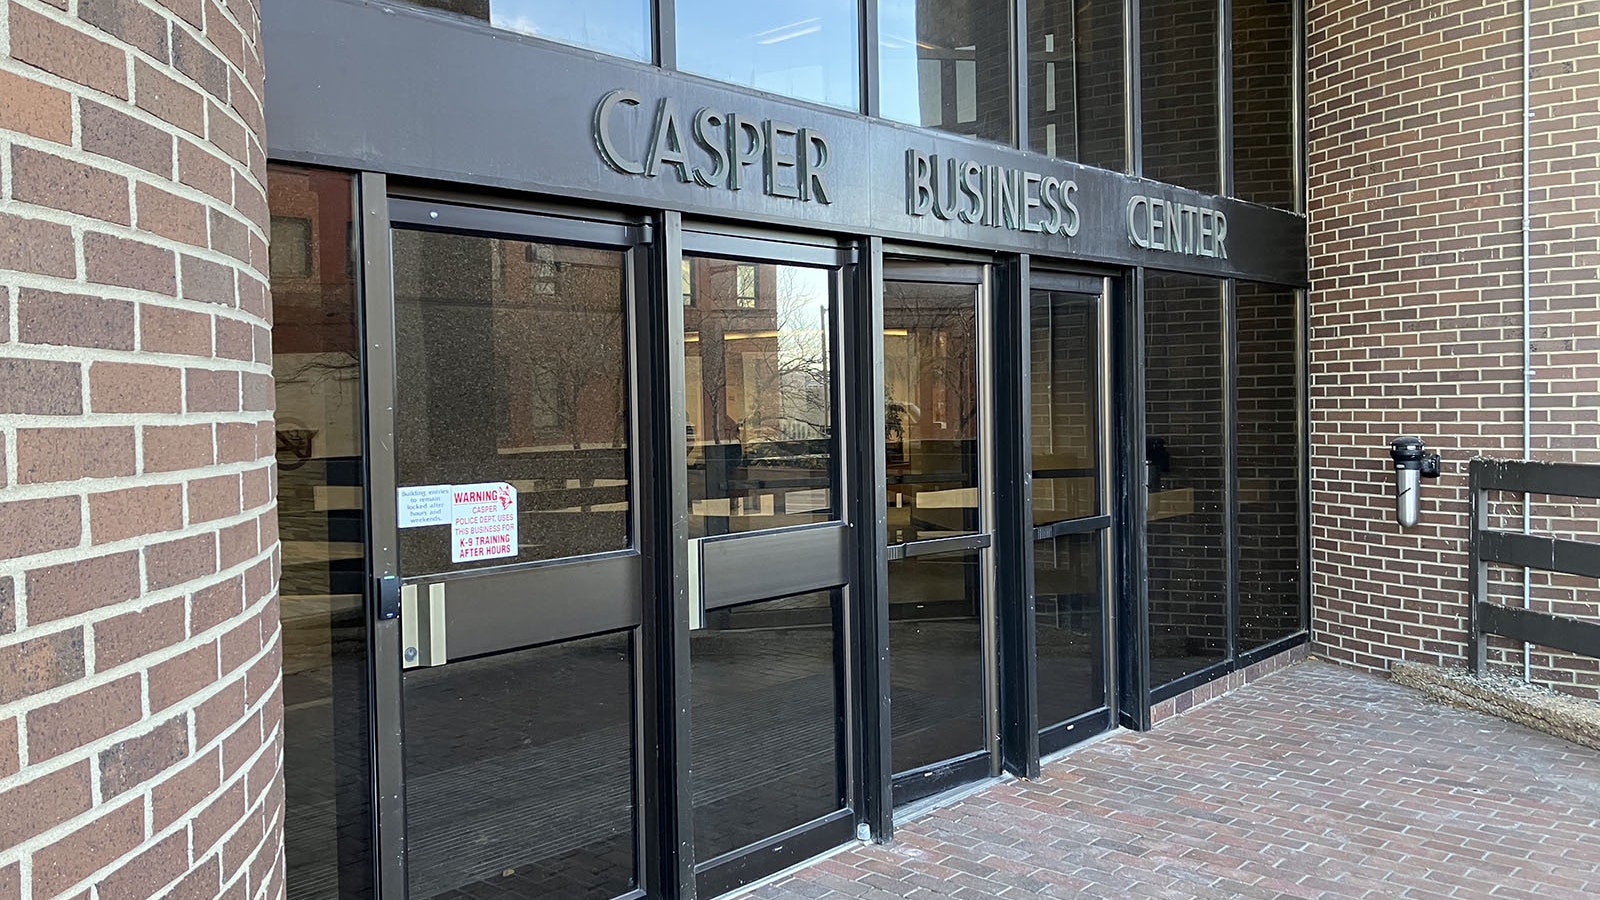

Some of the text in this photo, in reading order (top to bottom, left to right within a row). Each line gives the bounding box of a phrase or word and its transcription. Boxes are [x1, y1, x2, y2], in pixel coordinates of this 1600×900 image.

[594, 88, 1227, 260] CASPER BUSINESS CENTER
[454, 490, 498, 504] WARNING
[472, 505, 498, 514] CASPER
[455, 516, 478, 526] POLICE
[498, 513, 514, 522] USES
[455, 523, 514, 536] THIS BUSINESS FOR
[460, 533, 510, 547] K-9 TRAINING
[460, 544, 511, 559] AFTER HOURS
